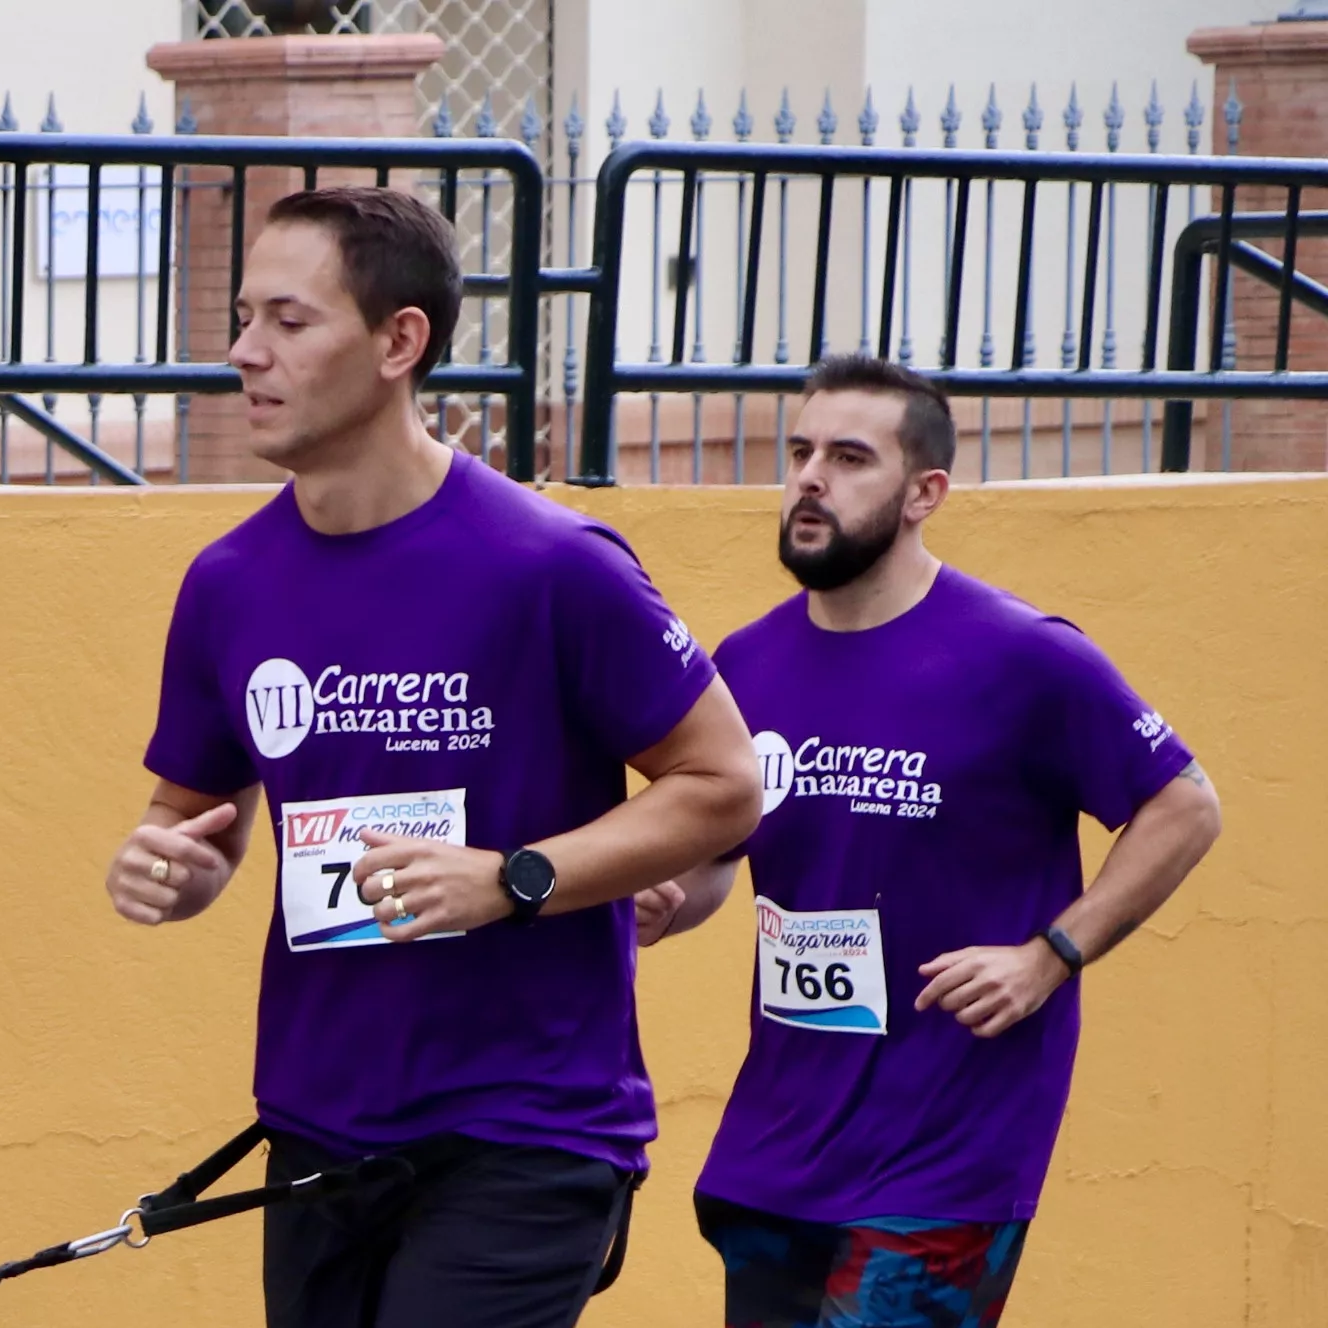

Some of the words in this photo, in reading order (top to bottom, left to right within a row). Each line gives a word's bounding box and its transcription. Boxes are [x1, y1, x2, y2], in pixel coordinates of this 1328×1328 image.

[312, 665, 469, 705] Carrera
[249, 684, 305, 733] VII
[315, 706, 496, 735] nazarena
[385, 737, 439, 751] Lucena
[447, 733, 491, 750] 2024
[794, 736, 927, 778] Carrera
[758, 752, 787, 790] II
[794, 774, 943, 804] nazarena
[351, 802, 456, 820] CARRERA
[850, 799, 892, 815] Lucena
[896, 802, 937, 818] 2024
[293, 814, 335, 844] VII
[293, 848, 326, 858] edición
[783, 918, 871, 931] CARRERA
[774, 956, 855, 1001] 766
